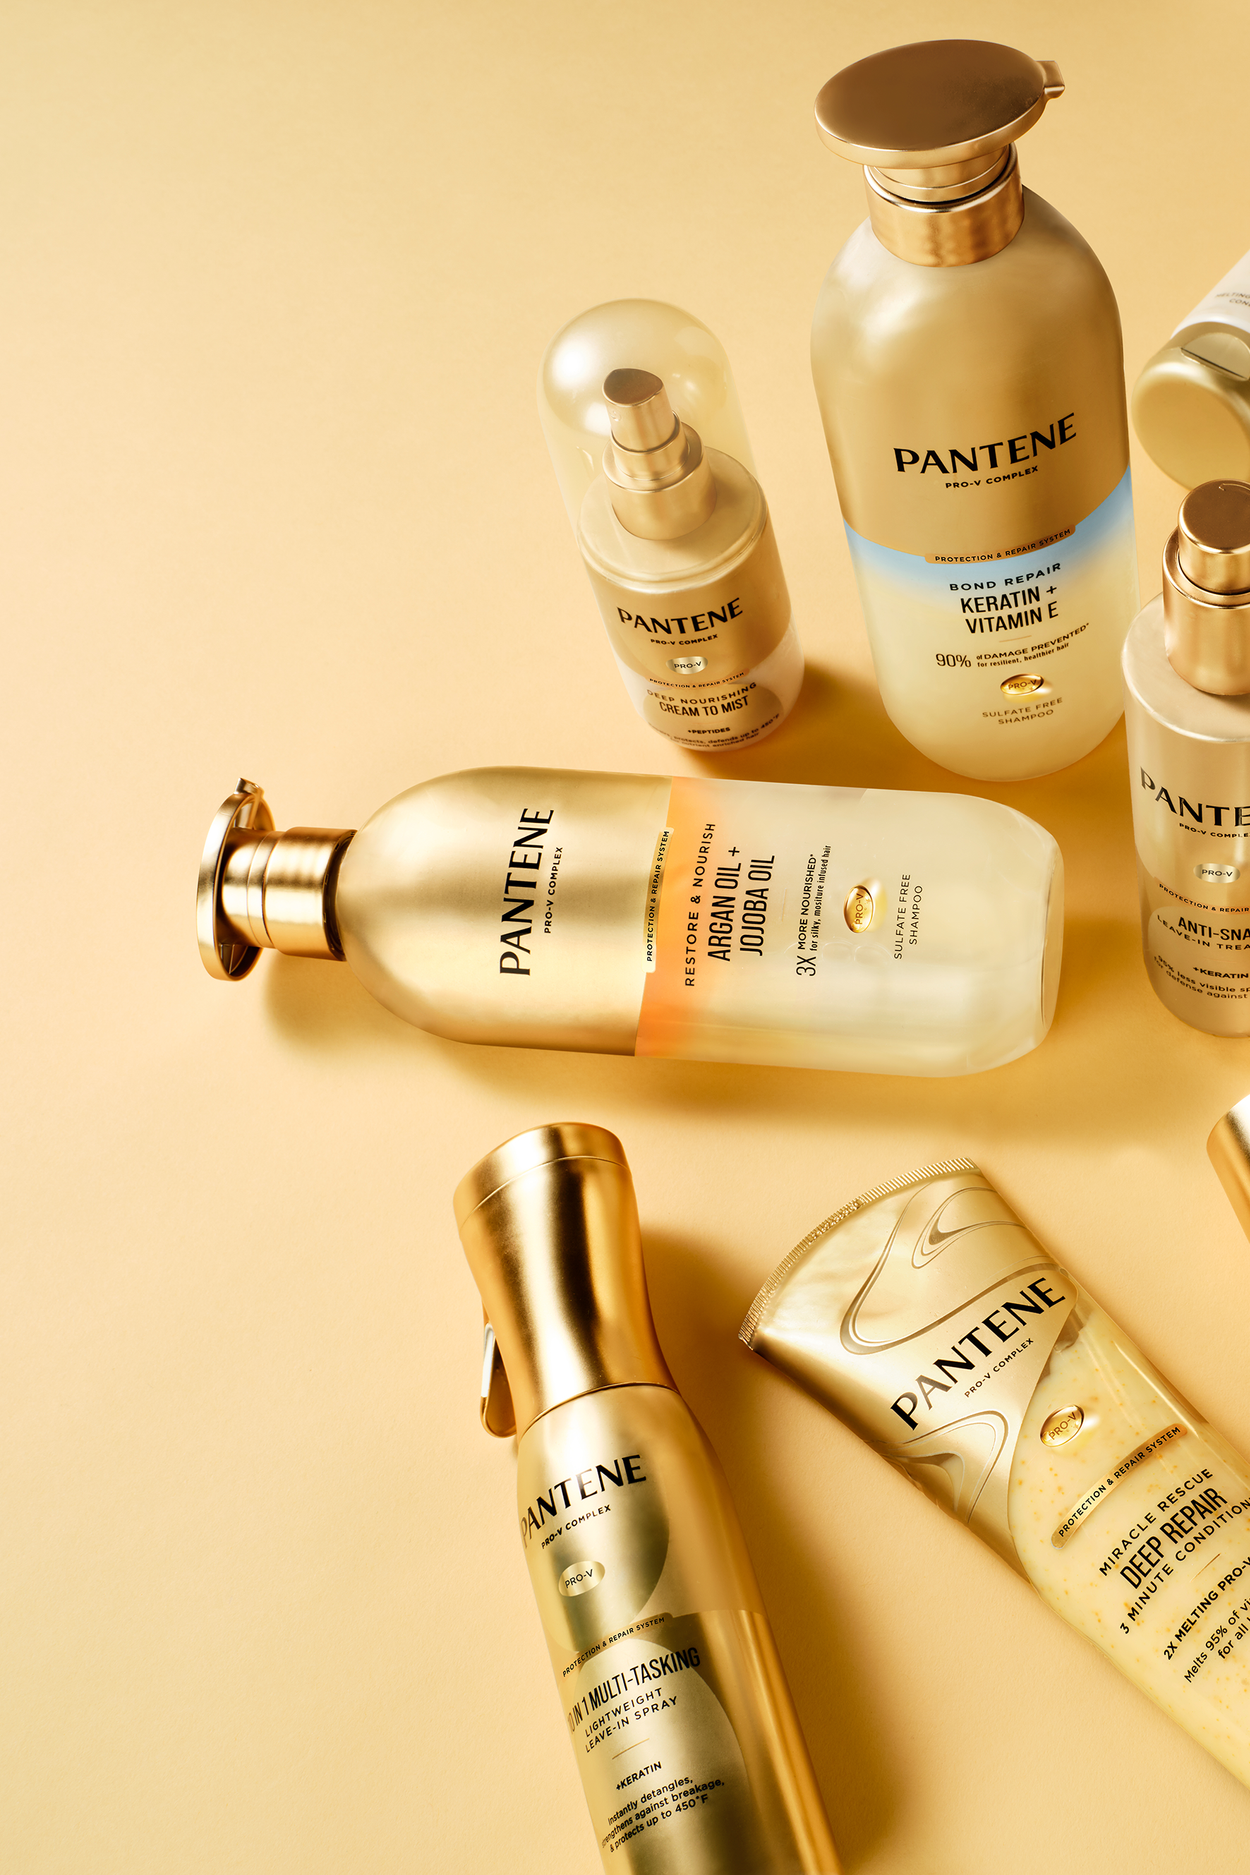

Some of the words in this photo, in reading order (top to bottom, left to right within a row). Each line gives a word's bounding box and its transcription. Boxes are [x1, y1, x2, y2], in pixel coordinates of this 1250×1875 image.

[893, 412, 1077, 474] PANTENE
[945, 480, 981, 488] PRO-V
[986, 465, 1038, 485] COMPLEX
[950, 580, 996, 591] BOND
[1005, 563, 1062, 586] REPAIR
[960, 586, 1040, 613] KERATIN
[1046, 585, 1057, 595] +
[617, 597, 743, 634] PANTENE
[966, 606, 1042, 633] VITAMIN
[1049, 601, 1058, 619] E
[647, 689, 675, 702] DEEP
[680, 682, 757, 704] NOURISHING
[659, 702, 699, 717] CREAM
[702, 705, 718, 716] TO
[721, 696, 750, 715] MIST
[547, 846, 563, 896] COMPLEX
[696, 823, 716, 886] NOURISH
[729, 846, 740, 857] +
[499, 807, 554, 975] PANTENE
[693, 895, 700, 904] &
[727, 863, 741, 891] OIL
[812, 918, 820, 938] silky,
[819, 858, 827, 882] infused
[544, 900, 552, 933] PRO-V
[708, 894, 736, 962] ARGAN
[740, 888, 769, 956] JOJOBA
[756, 855, 775, 882] OIL
[894, 912, 905, 959] SULFATE
[901, 874, 910, 902] FREE
[909, 885, 923, 945] SHAMPOO
[1157, 914, 1210, 947] LEAVE-IN
[685, 911, 699, 986] RESTORE
[798, 923, 809, 949] MORE
[796, 956, 816, 976] 3X
[1193, 967, 1249, 978] +KERATIN
[889, 1277, 1065, 1430] PANTENE
[964, 1372, 992, 1398] PRO-V
[993, 1338, 1034, 1373] COMPLEX
[1048, 1410, 1078, 1441] PRO-V
[520, 1454, 646, 1549] PANTENE
[541, 1527, 563, 1549] PRO-V
[565, 1504, 611, 1531] COMPLEX
[1099, 1514, 1157, 1576] MIRACLE
[1157, 1468, 1213, 1513] RESCUE
[1119, 1536, 1162, 1590] DEEP
[1160, 1487, 1227, 1540] REPAIR
[564, 1569, 593, 1589] PRO-V
[1120, 1621, 1130, 1634] 3
[1127, 1564, 1174, 1619] MINUTE
[1163, 1641, 1178, 1660] 2X
[1174, 1590, 1219, 1642] MELTING
[1184, 1650, 1209, 1683] Melts
[1205, 1625, 1229, 1651] 95%
[1227, 1609, 1241, 1627] of
[1217, 1643, 1235, 1660] for
[1234, 1626, 1249, 1644] all
[572, 1702, 583, 1726] IN
[582, 1696, 590, 1716] 1
[588, 1646, 701, 1712] MULTI-TASKING
[585, 1687, 663, 1737] LIGHTWEIGHT
[585, 1716, 630, 1753] LEAVE-IN
[635, 1696, 678, 1722] SPRAY
[615, 1761, 662, 1791] +KERATIN
